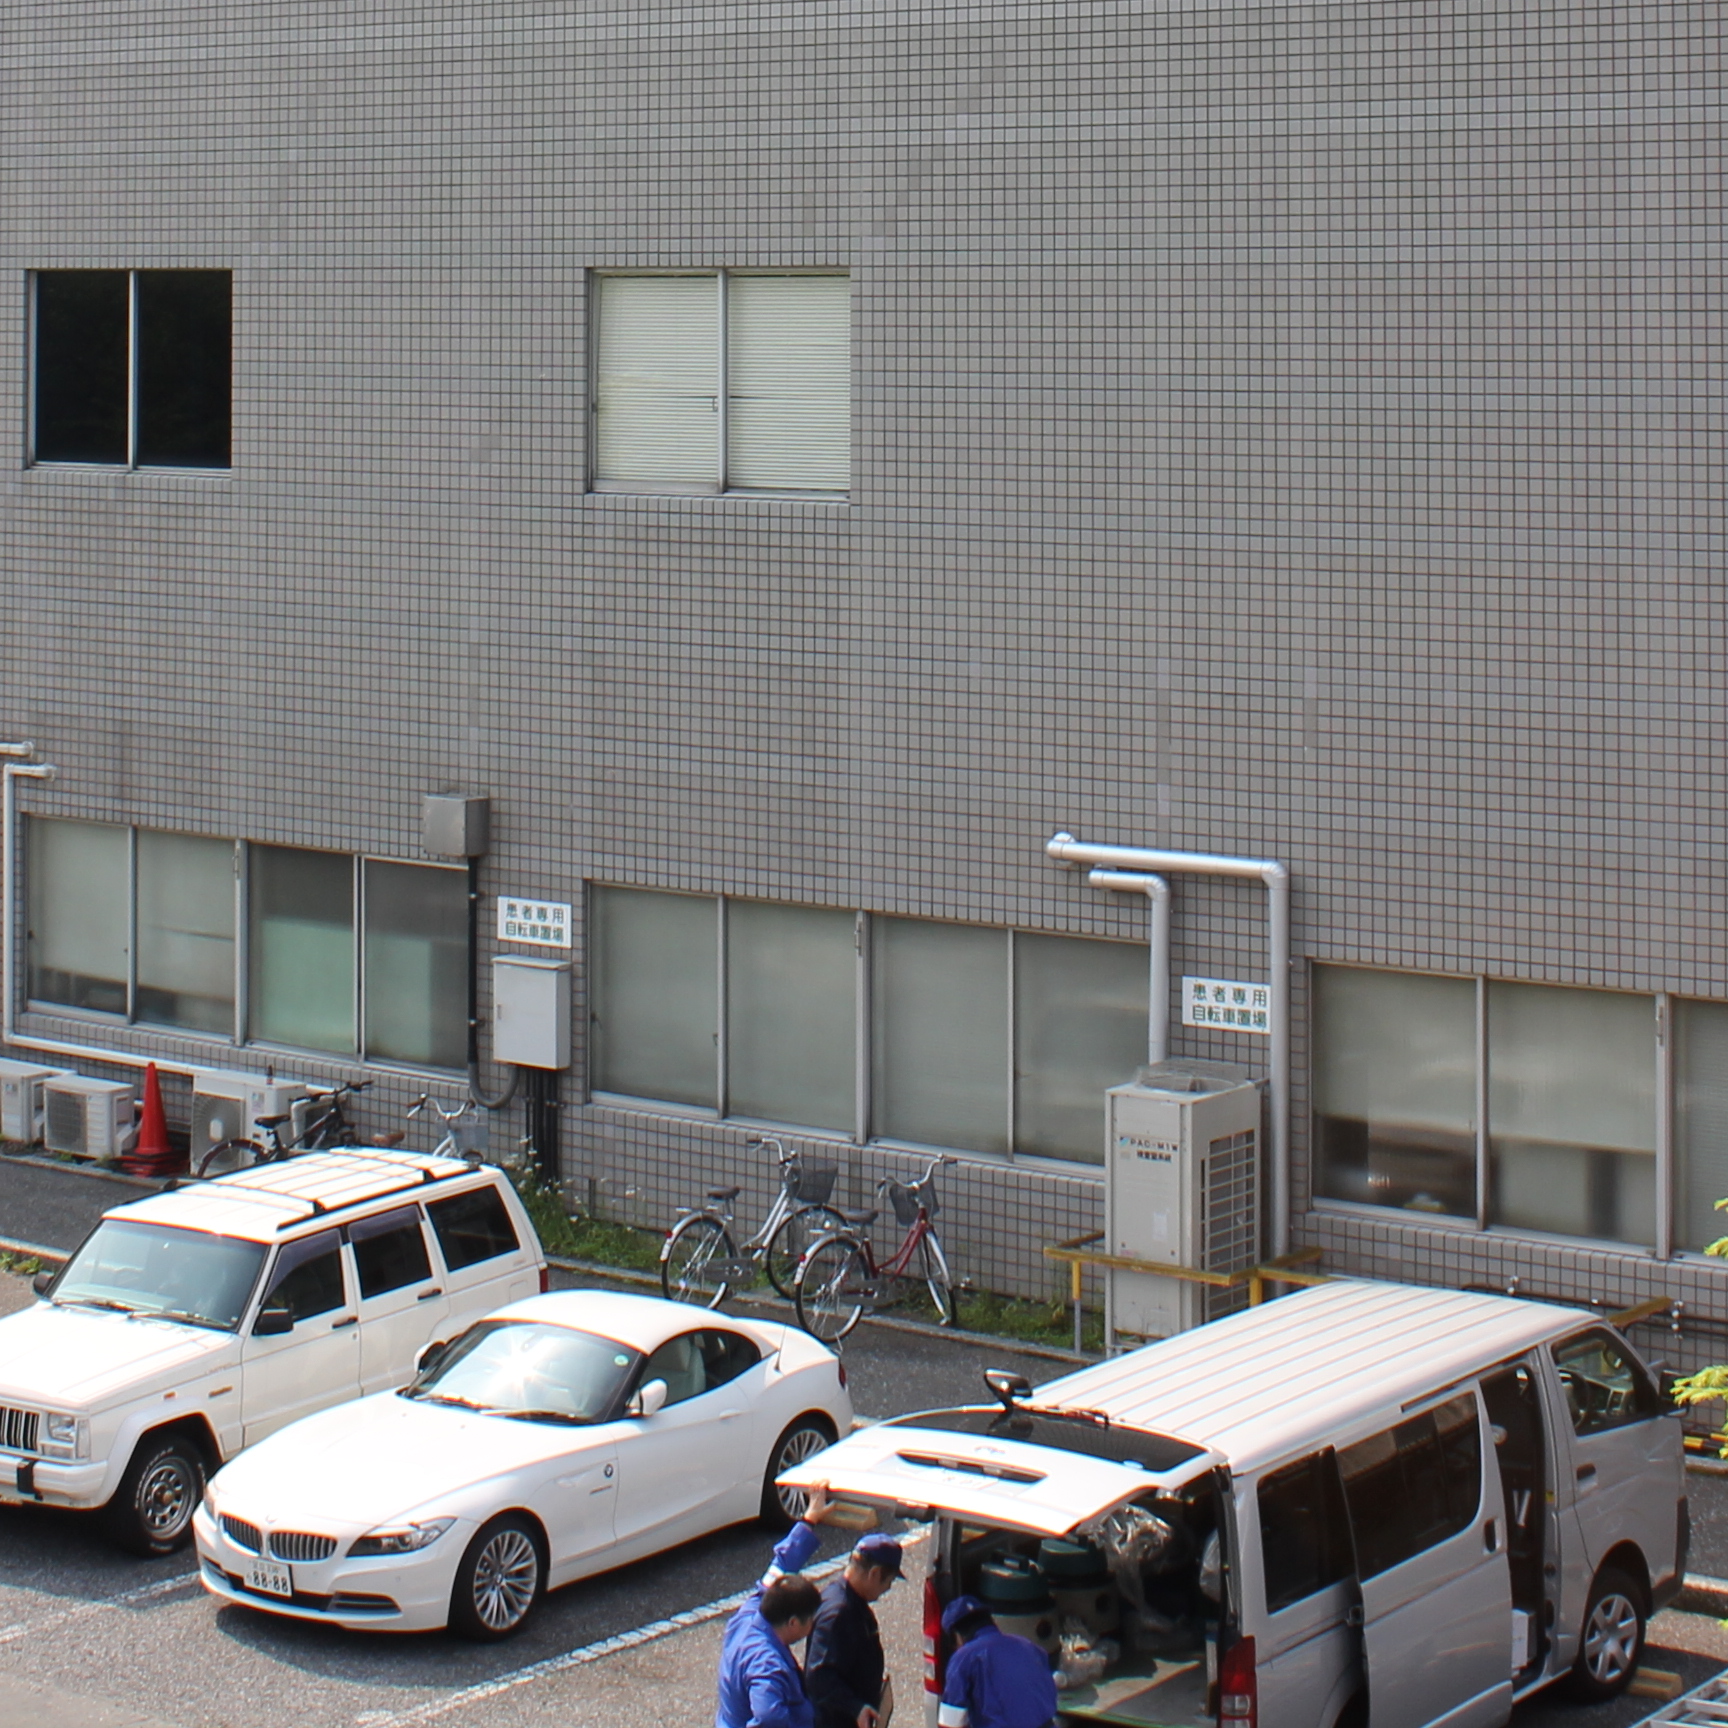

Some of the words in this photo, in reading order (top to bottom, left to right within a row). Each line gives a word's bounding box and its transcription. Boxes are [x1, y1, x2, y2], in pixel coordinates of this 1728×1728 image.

[506, 902, 564, 924] 患者専用
[505, 920, 564, 943] 自転車置場
[1192, 983, 1267, 1007] 患者専用
[1192, 1004, 1267, 1028] 自転車置場
[253, 1570, 289, 1593] 88-88
